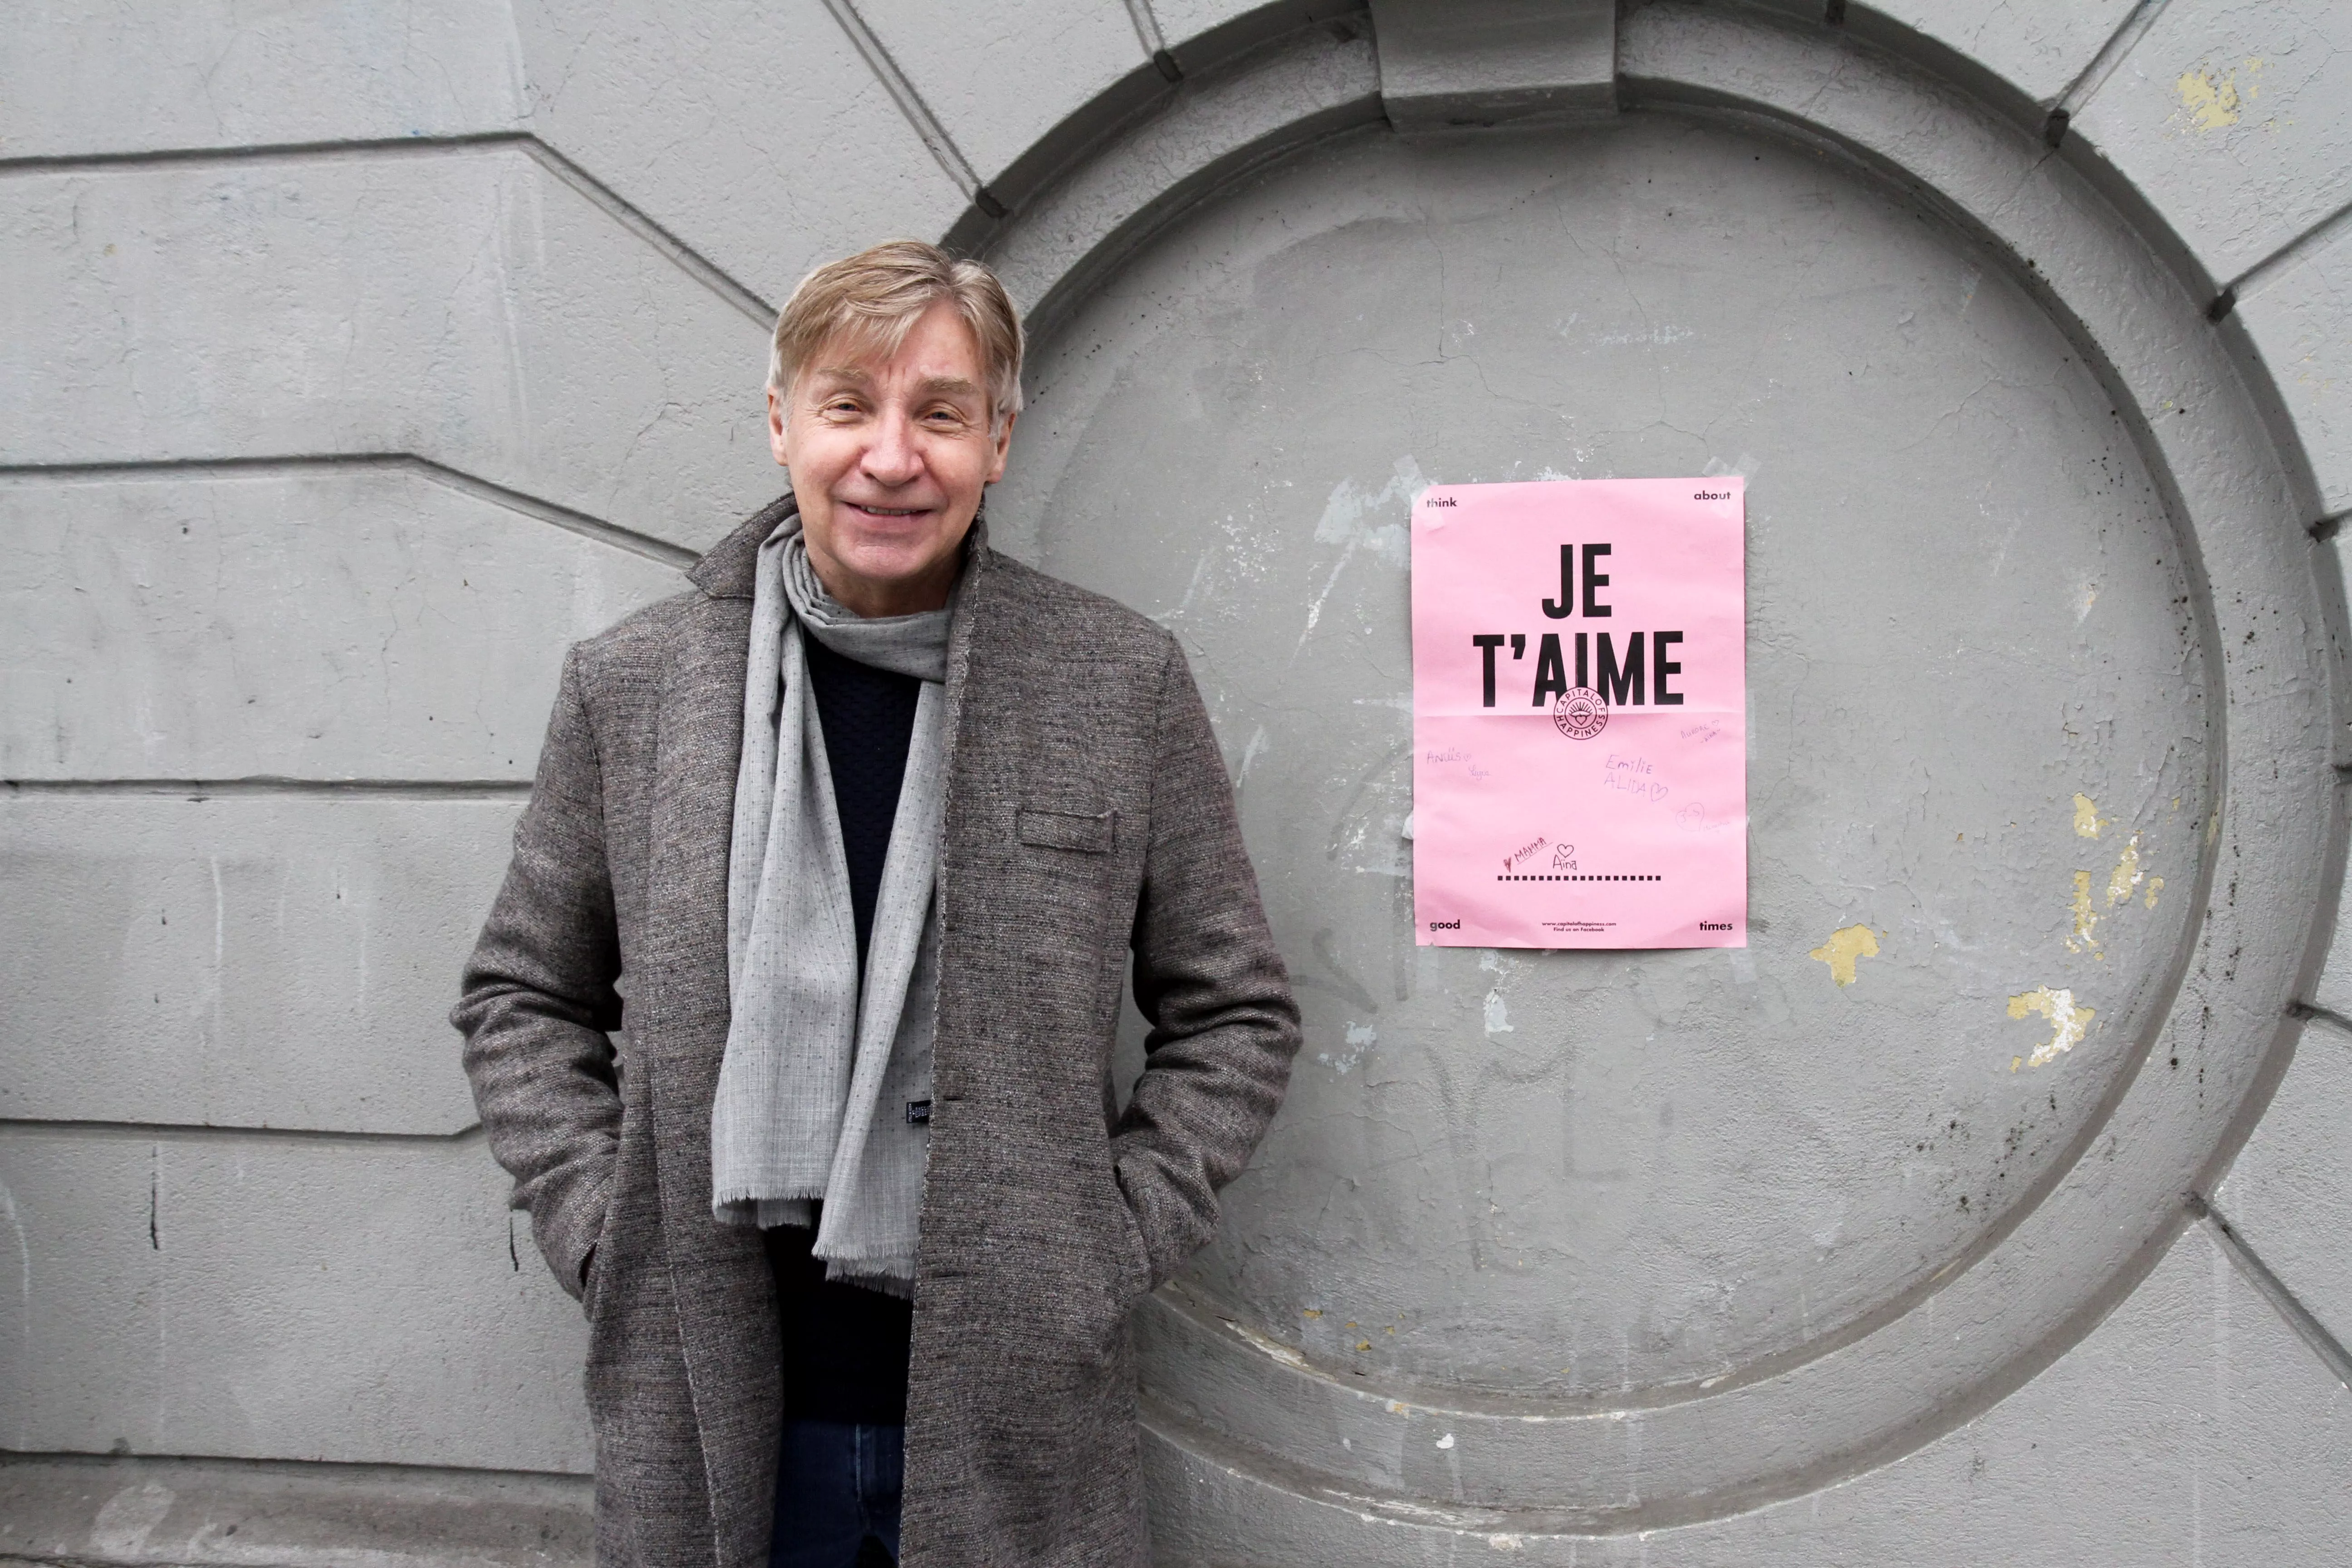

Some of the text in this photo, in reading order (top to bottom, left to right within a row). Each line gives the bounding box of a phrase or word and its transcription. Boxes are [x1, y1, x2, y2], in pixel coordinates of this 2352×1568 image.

[1694, 490, 1731, 500] about
[1427, 497, 1457, 508] think
[1542, 543, 1612, 619] JE
[1473, 631, 1684, 707] T’AIME
[1557, 715, 1605, 737] HAPPINESS
[1430, 919, 1460, 932] good
[1699, 921, 1733, 931] times
